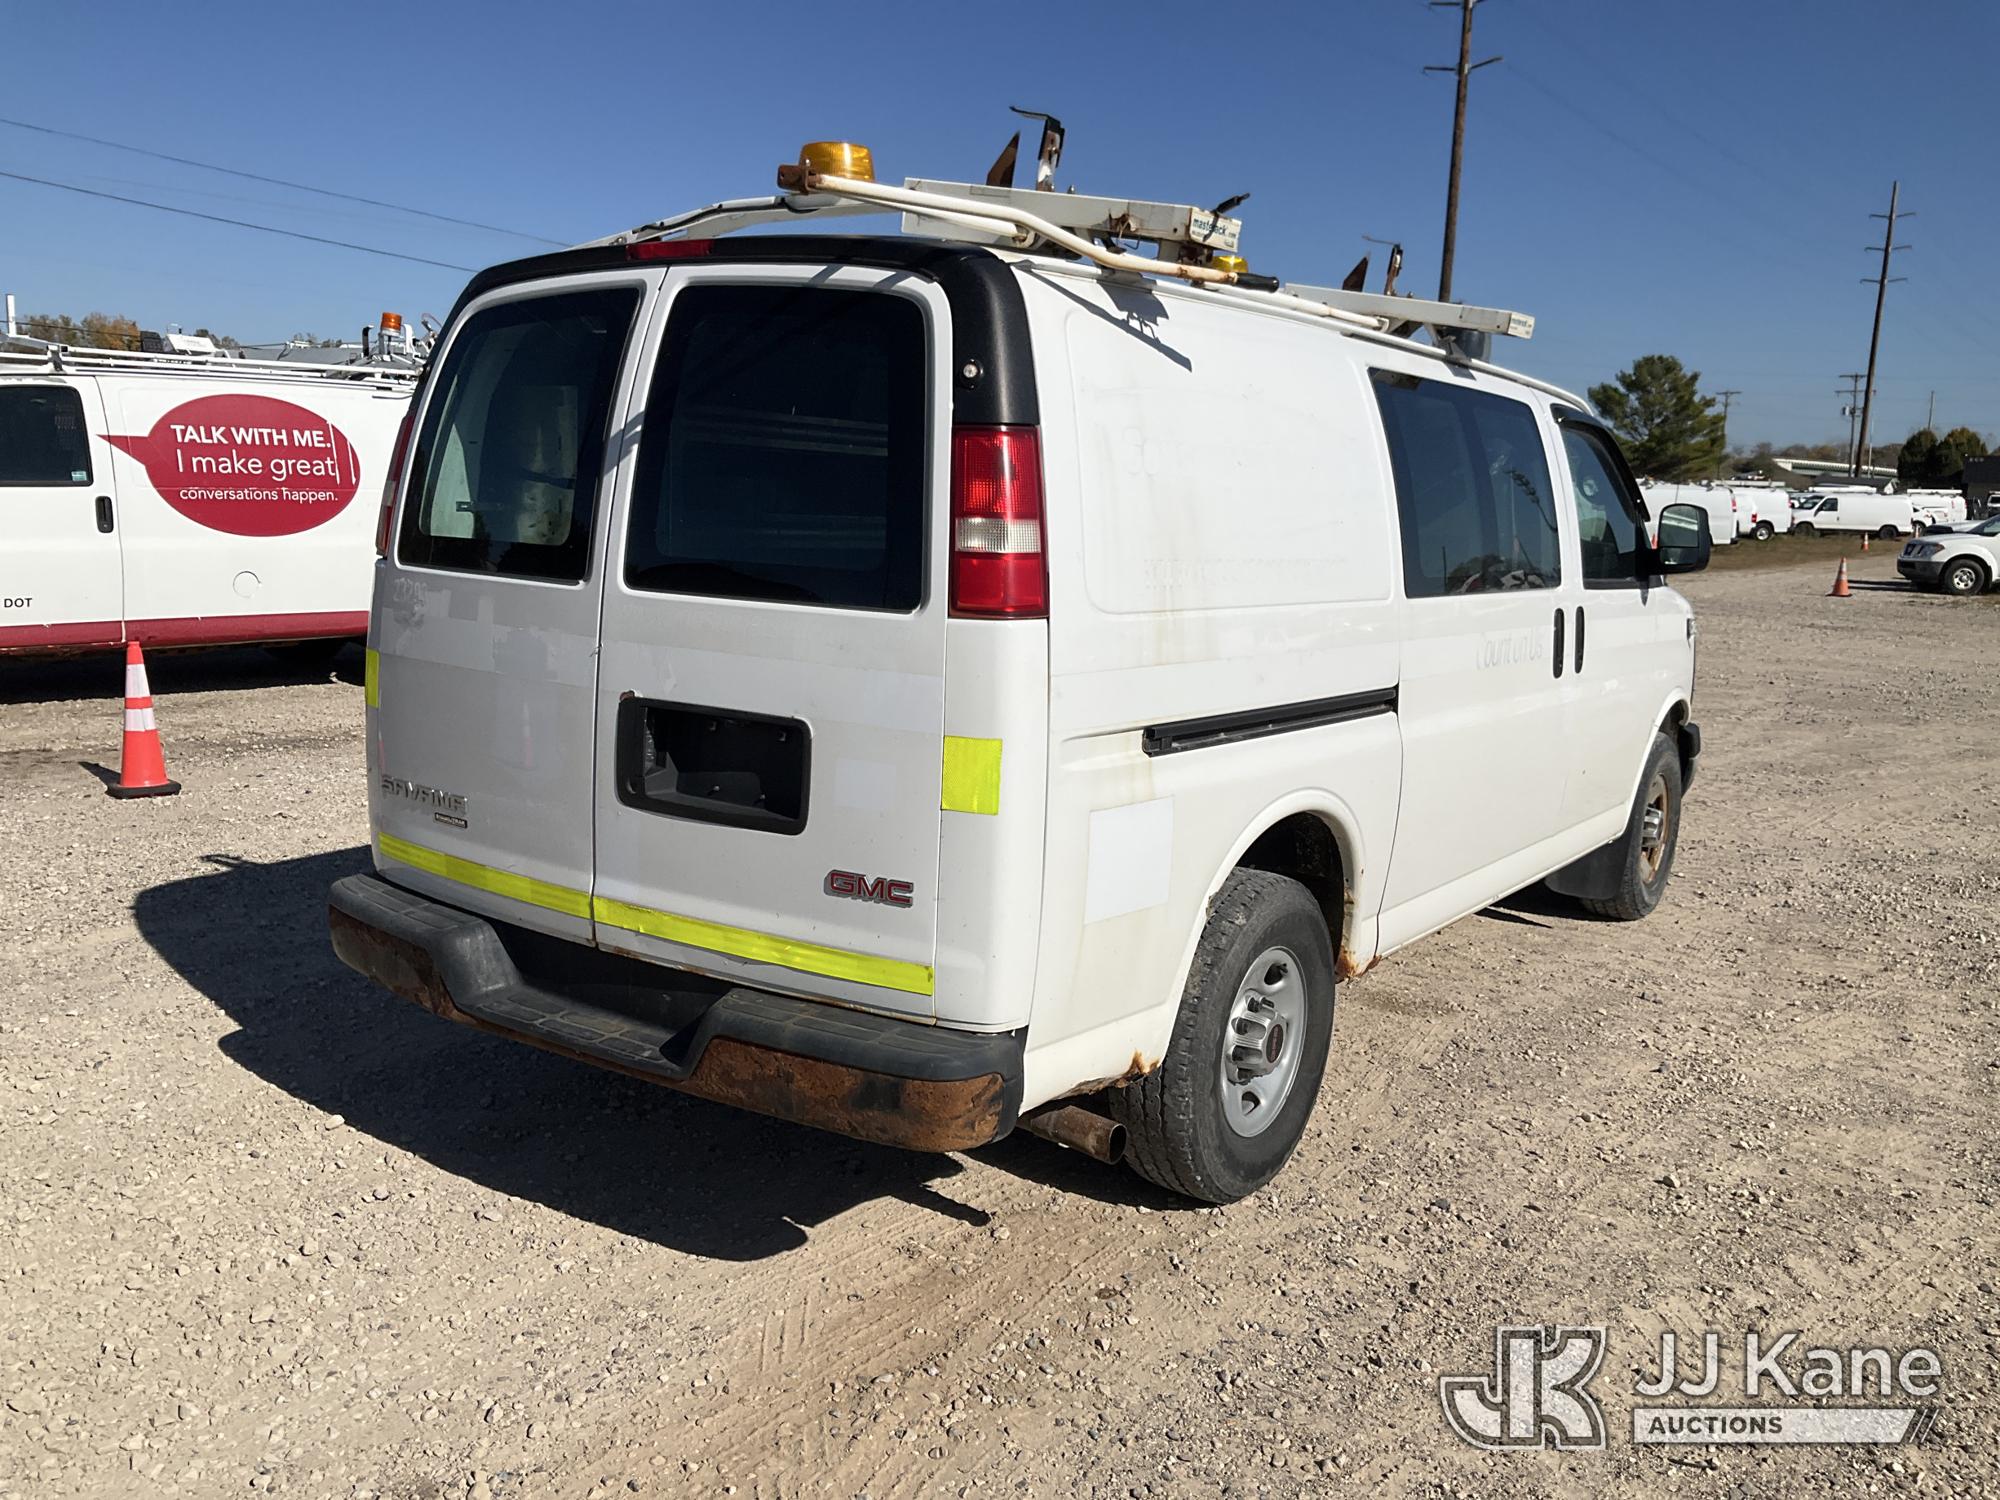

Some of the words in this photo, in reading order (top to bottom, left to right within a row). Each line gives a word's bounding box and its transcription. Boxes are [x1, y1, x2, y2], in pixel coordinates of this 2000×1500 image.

[170, 424, 229, 445] TALK
[231, 427, 288, 447] WITH
[293, 430, 332, 448] ME.
[176, 448, 184, 473] I
[192, 449, 263, 475] make
[270, 456, 336, 482] great
[179, 488, 279, 501] conversations
[283, 487, 339, 504] happen.
[3, 597, 33, 608] DOT
[825, 870, 914, 908] GMC
